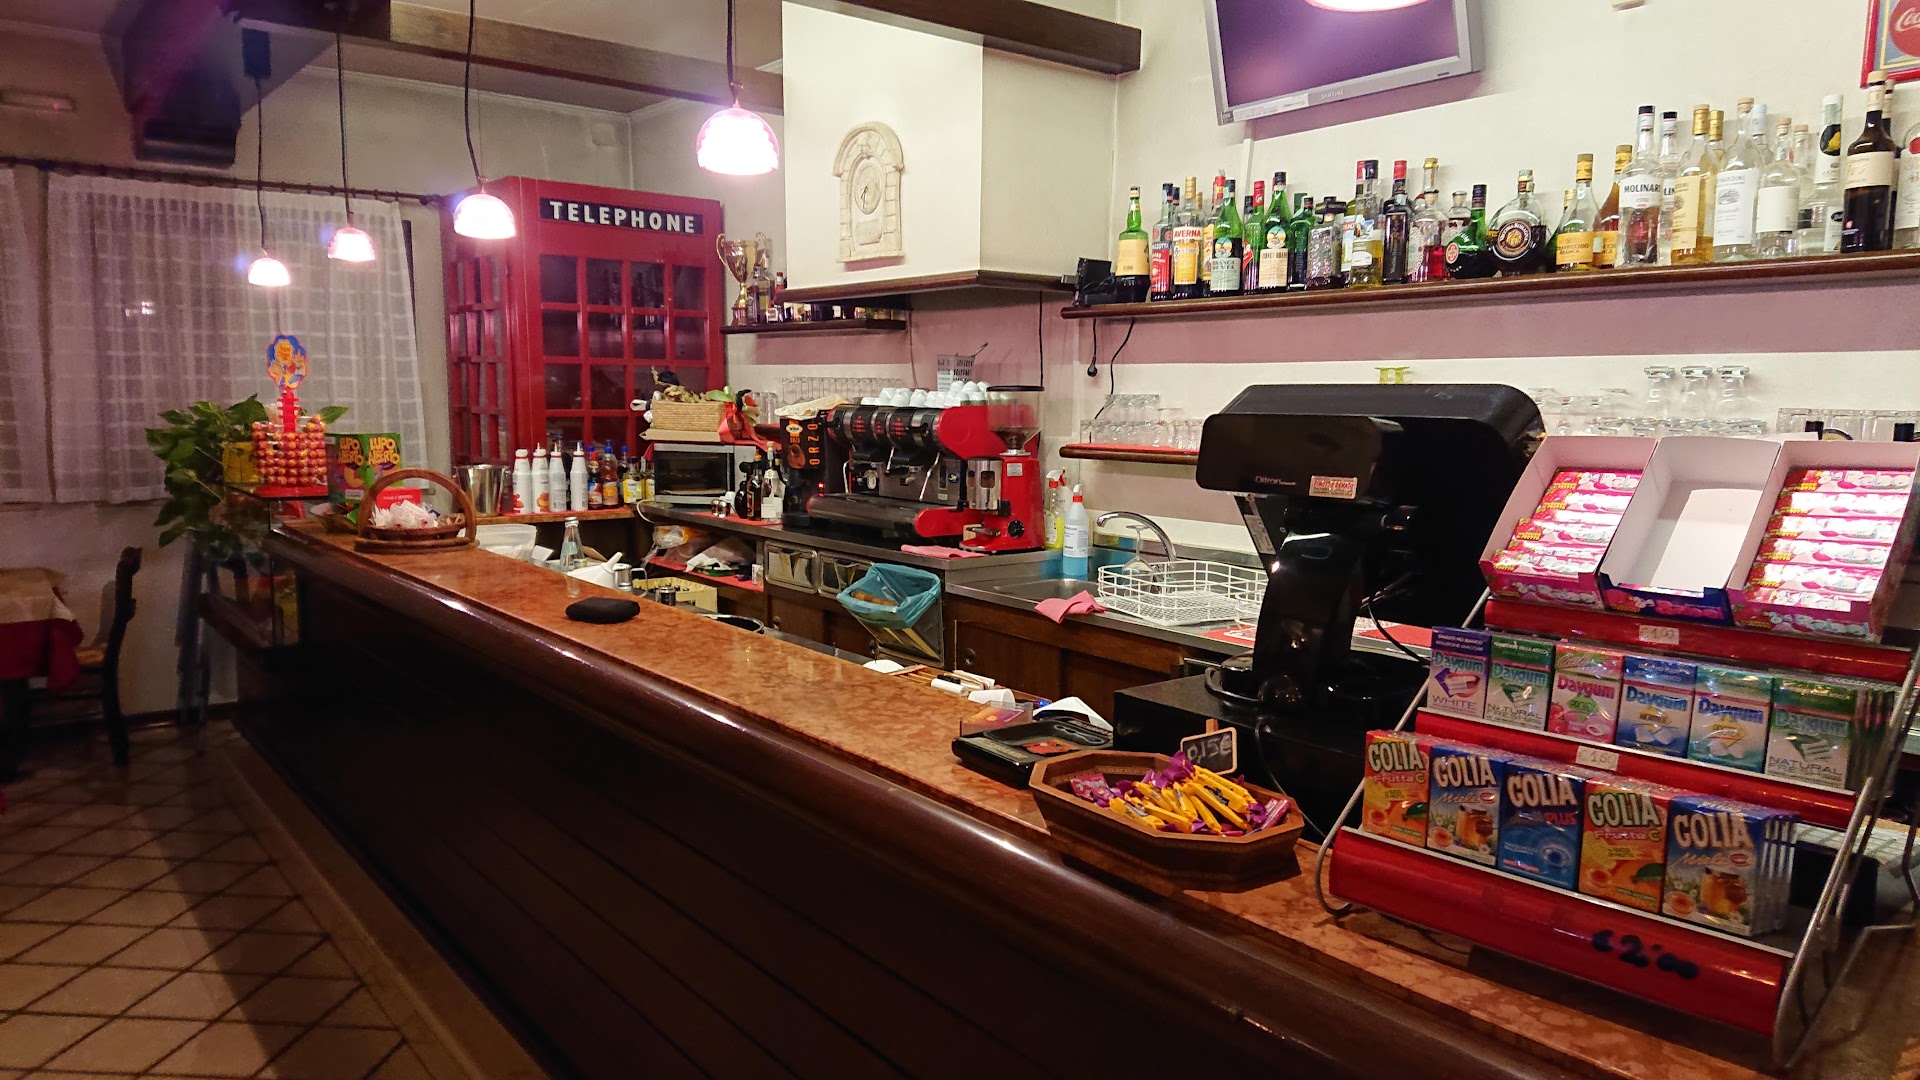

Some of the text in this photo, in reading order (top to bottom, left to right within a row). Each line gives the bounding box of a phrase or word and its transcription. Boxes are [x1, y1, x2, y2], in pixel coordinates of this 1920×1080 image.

[549, 201, 695, 234] TELEPHONE
[1174, 229, 1202, 238] AVERNA
[369, 436, 396, 451] LUPO
[807, 423, 820, 465] ORZO
[1434, 651, 1485, 674] Daygum
[1492, 661, 1548, 686] Daygum
[1557, 675, 1615, 699] Daygum
[1626, 685, 1688, 712] Daygum
[1432, 695, 1477, 709] WHITE
[1487, 703, 1544, 719] NATURAL
[1698, 696, 1764, 724] Daygum
[1774, 708, 1849, 738] Daygum
[1768, 756, 1843, 776] NATURAL
[1373, 773, 1413, 784] Frutta
